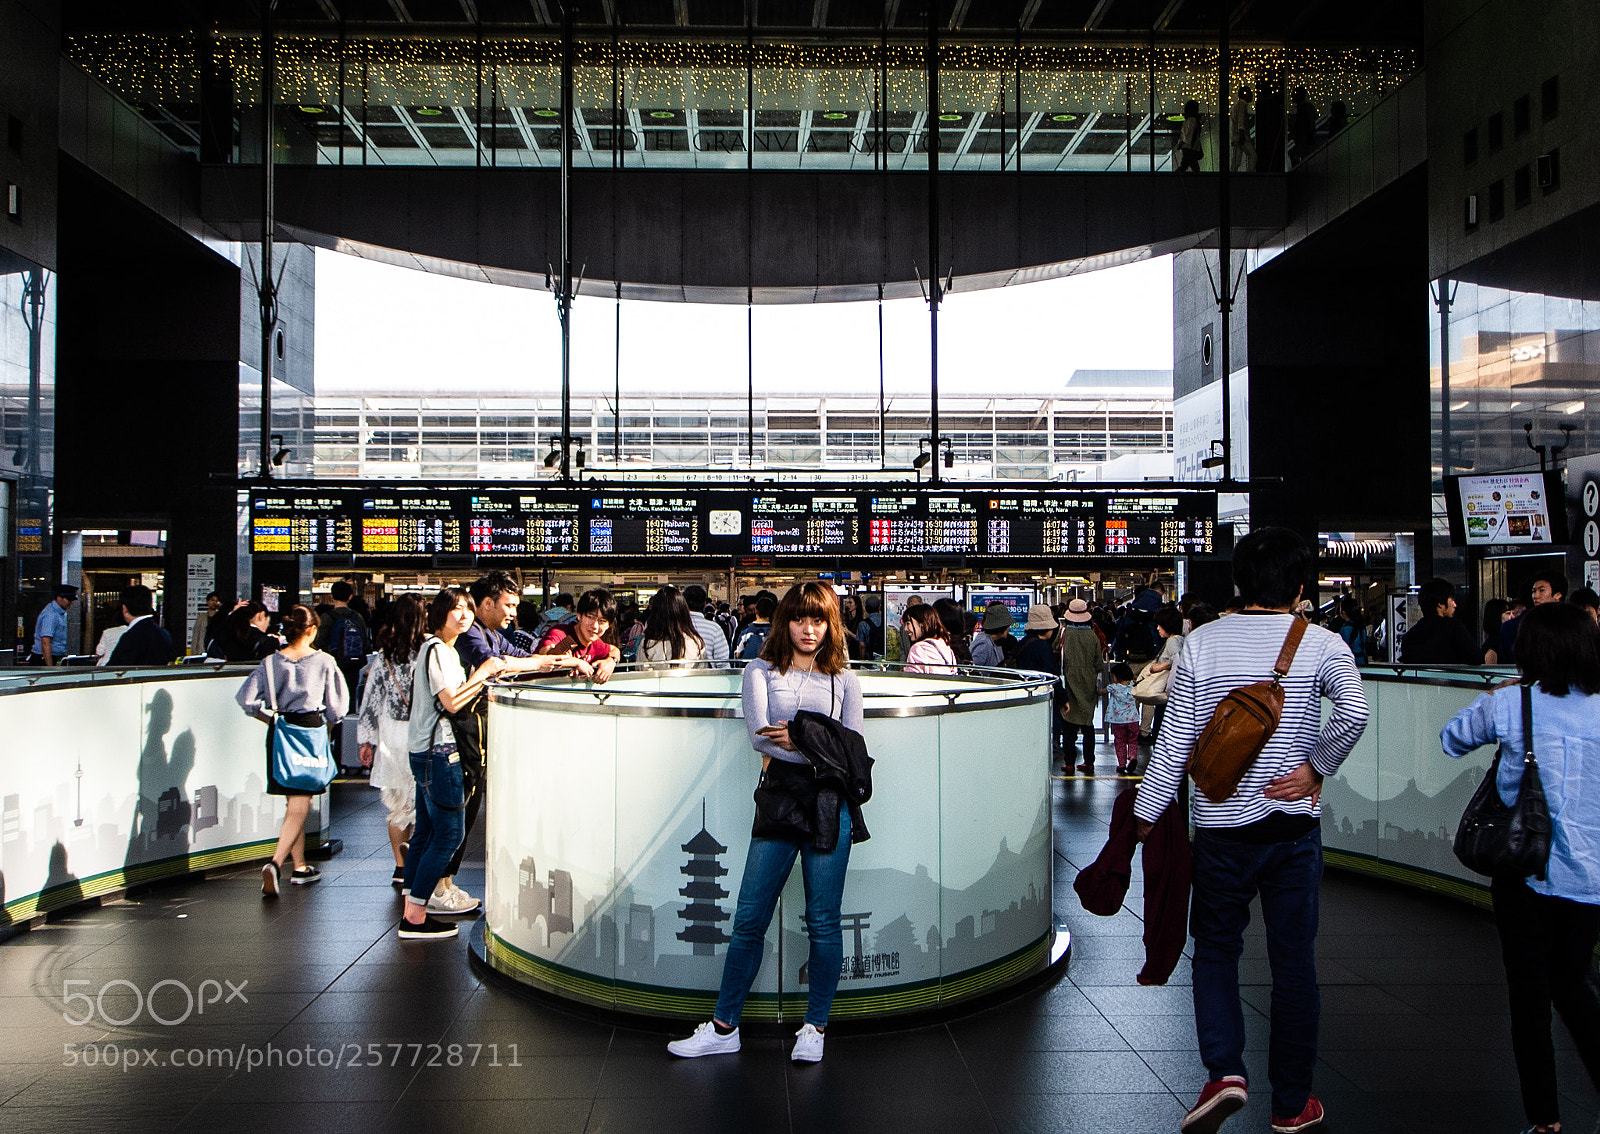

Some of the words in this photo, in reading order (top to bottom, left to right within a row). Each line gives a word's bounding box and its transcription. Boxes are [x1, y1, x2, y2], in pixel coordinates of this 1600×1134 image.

[597, 130, 678, 150] HOTEL
[693, 132, 818, 154] GRANVIA
[848, 132, 941, 156] KYOTO
[1161, 520, 1178, 529] 16:07
[1205, 520, 1212, 529] 33
